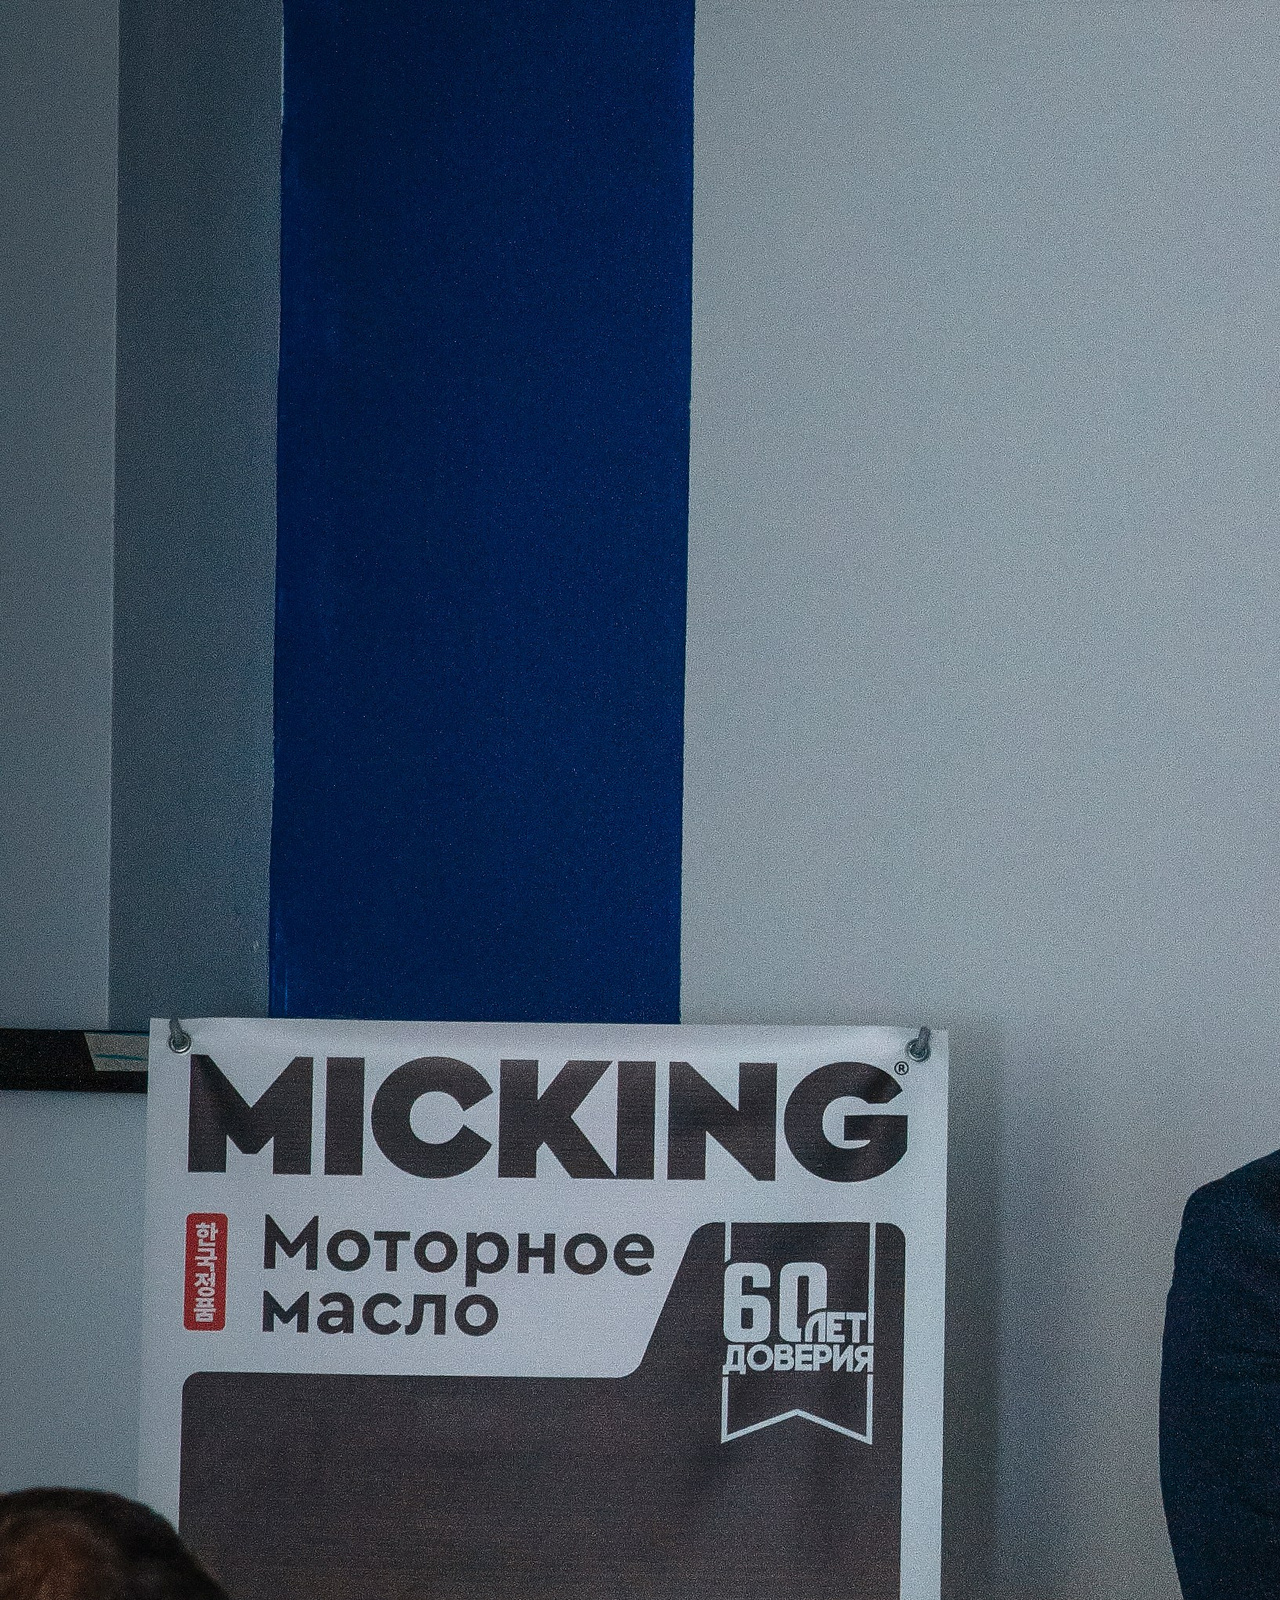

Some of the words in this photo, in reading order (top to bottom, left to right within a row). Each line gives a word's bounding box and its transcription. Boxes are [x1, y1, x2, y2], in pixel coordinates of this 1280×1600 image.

[263, 1213, 656, 1287] Моторное
[262, 1288, 499, 1336] масло
[723, 1262, 828, 1342] 60
[804, 1311, 867, 1343] ЛЕТ
[722, 1343, 874, 1375] ДОВЕРИЯ
